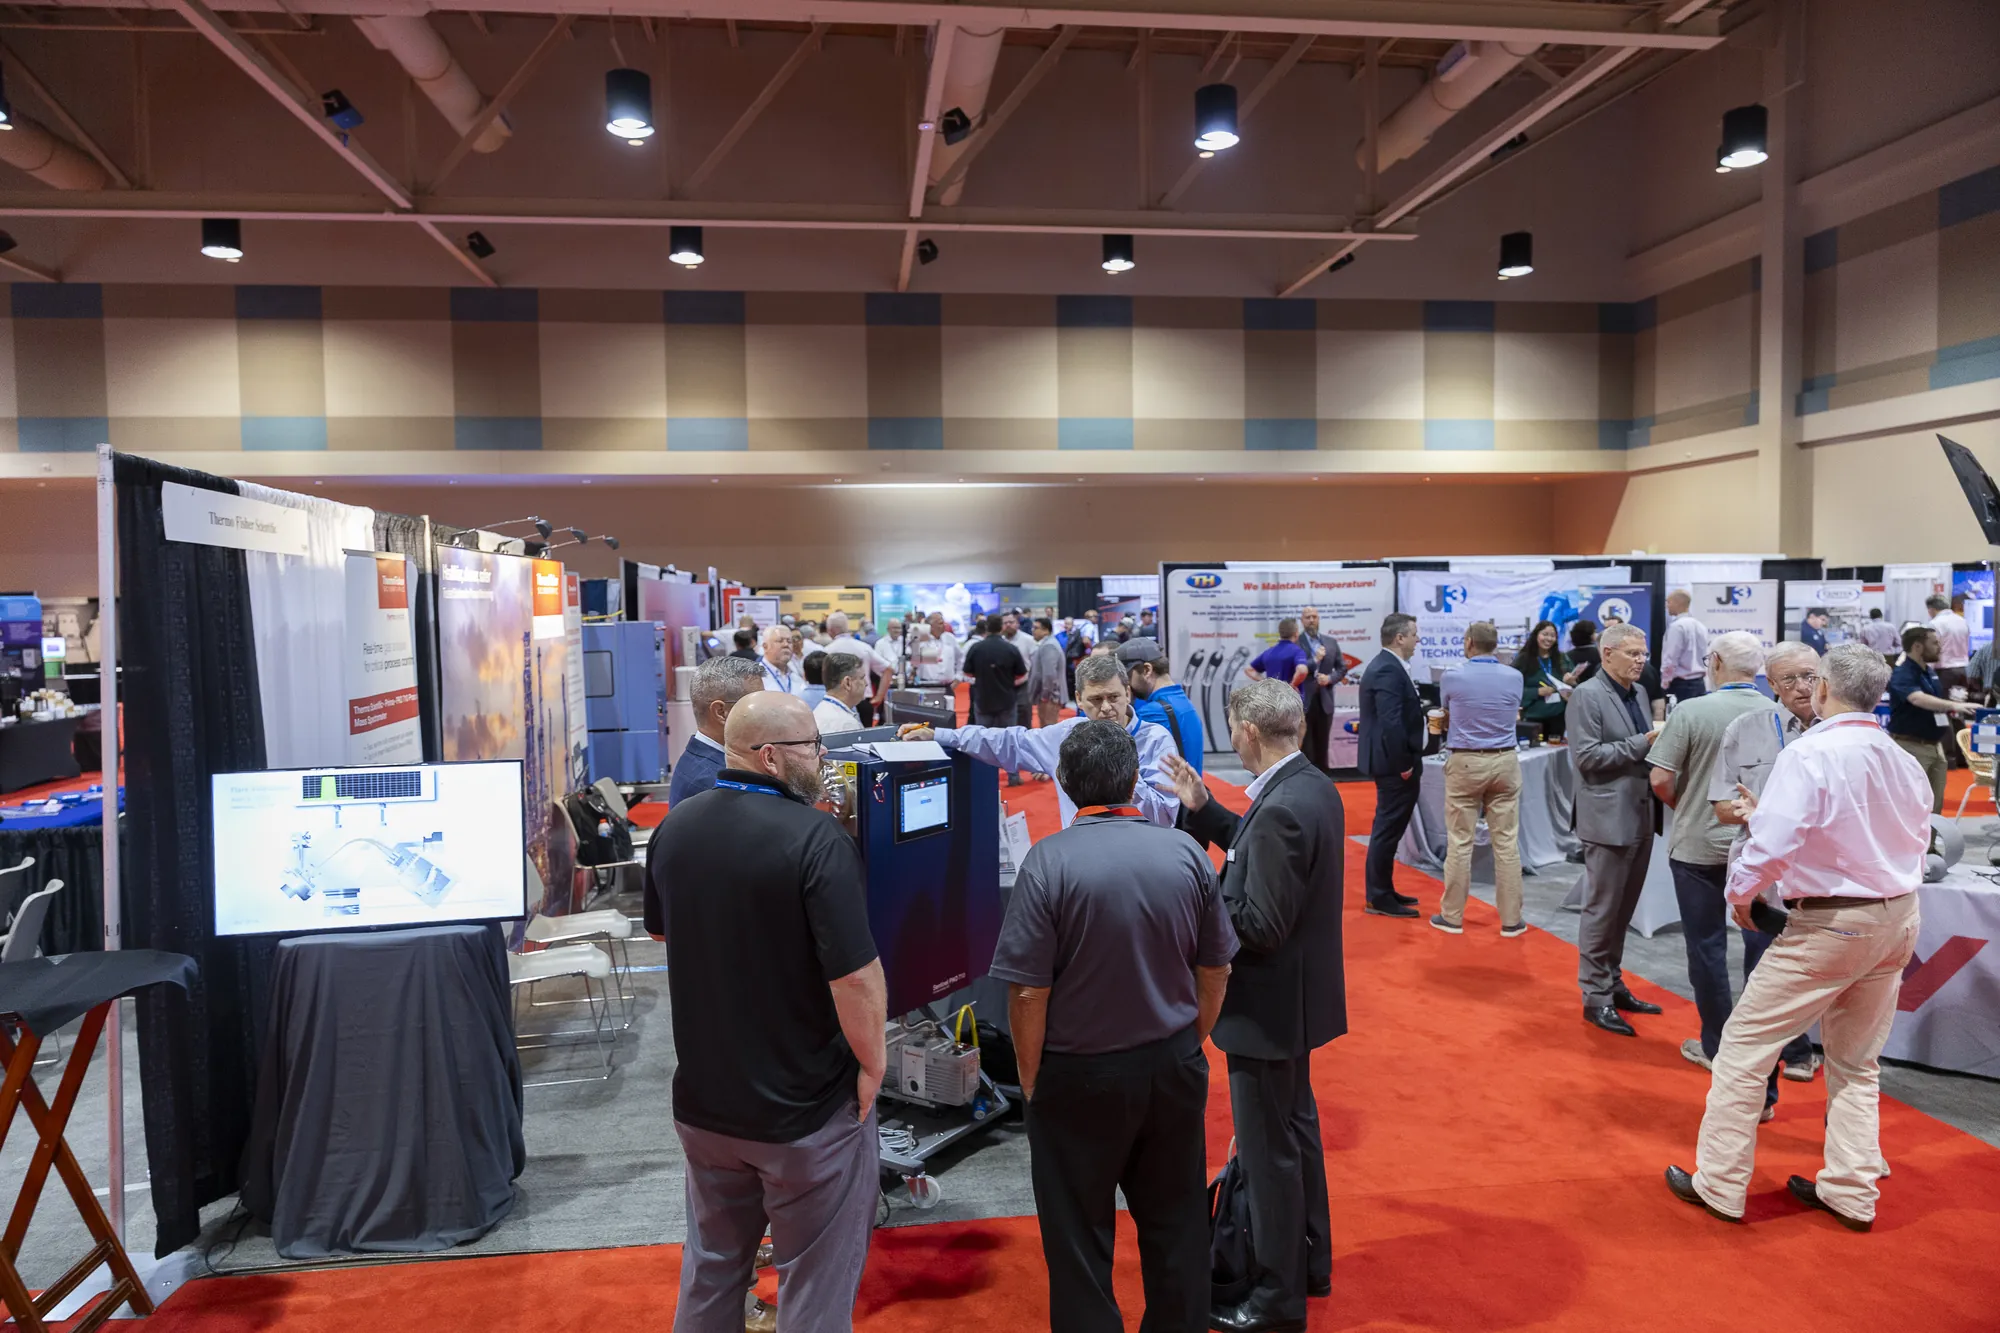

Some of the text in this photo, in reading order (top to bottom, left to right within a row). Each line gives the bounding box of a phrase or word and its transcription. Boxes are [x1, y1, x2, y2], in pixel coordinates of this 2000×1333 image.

[208, 511, 278, 534] Thermo Fisher Scientific
[1192, 574, 1216, 588] TH
[1243, 579, 1376, 591] We Maintain Temperature!
[1420, 636, 1438, 646] OIL
[1440, 637, 1448, 646] &
[354, 718, 368, 727] Mass
